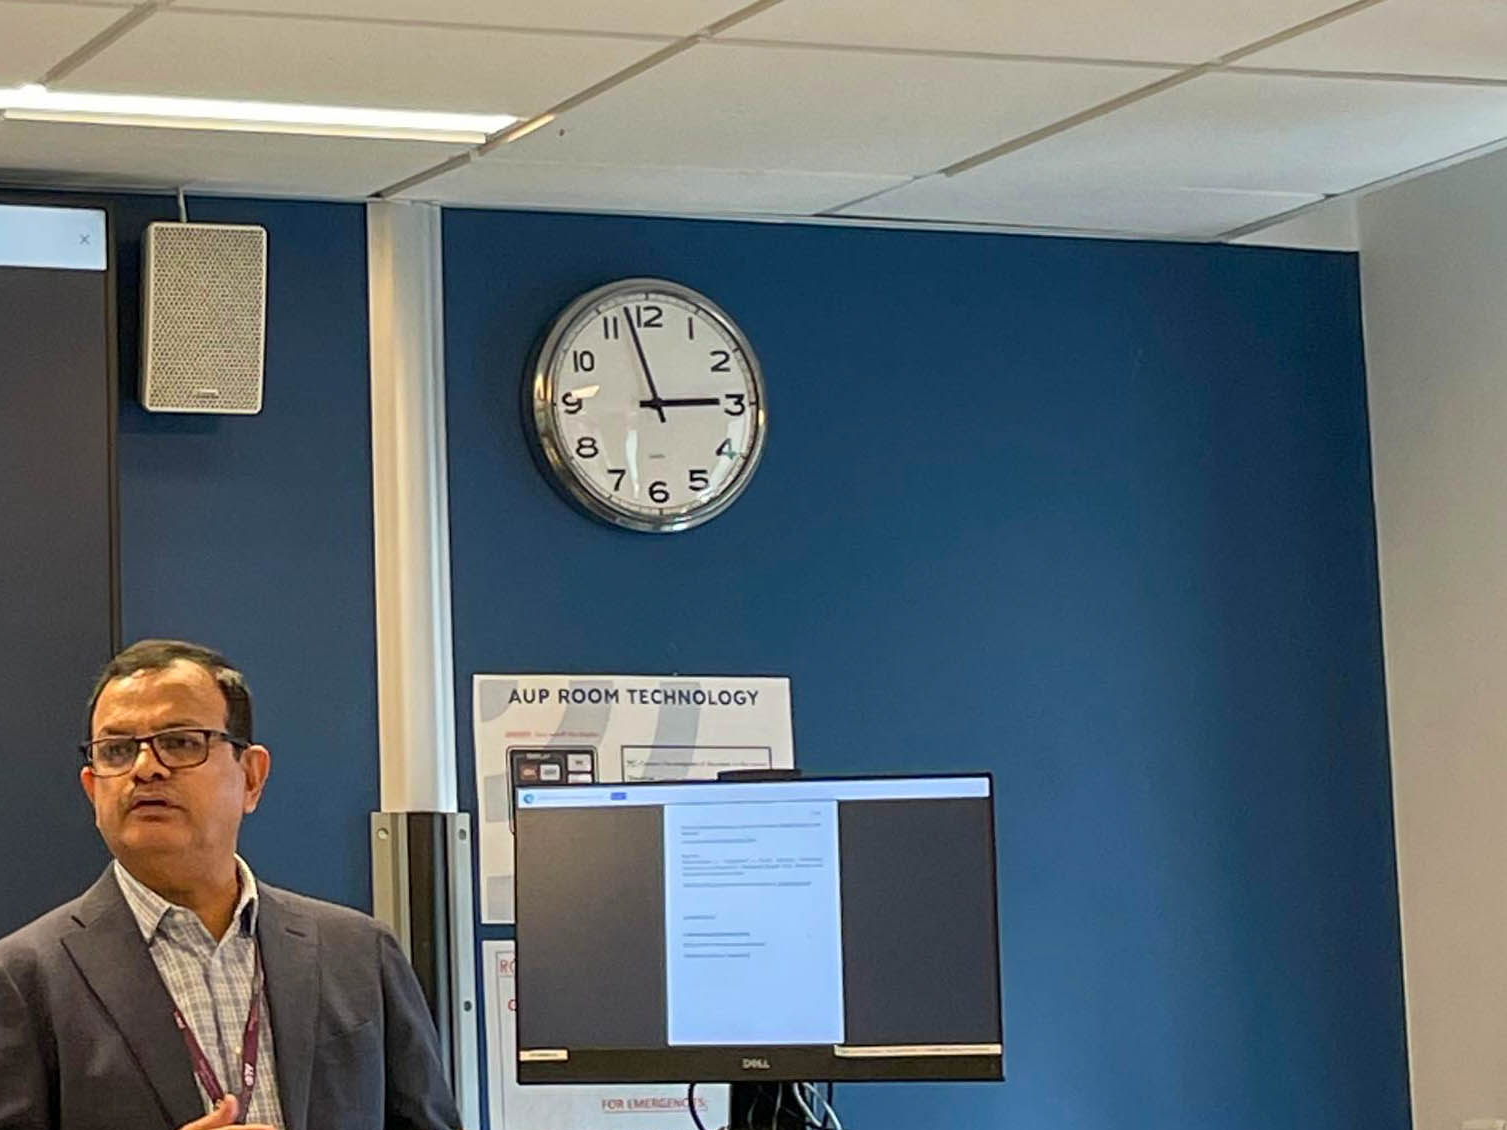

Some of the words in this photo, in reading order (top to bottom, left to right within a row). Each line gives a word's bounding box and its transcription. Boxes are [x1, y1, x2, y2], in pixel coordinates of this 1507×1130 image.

[602, 316, 619, 340] 11
[635, 305, 664, 328] 12
[687, 316, 695, 340] 1
[572, 350, 595, 373] 10
[709, 350, 732, 373] 2
[561, 391, 584, 415] 9
[723, 393, 746, 417] 3
[575, 436, 599, 459] 8
[715, 438, 738, 460] 4
[607, 469, 626, 492] 7
[688, 469, 709, 492] 5
[648, 481, 670, 504] 6
[508, 688, 550, 705] AUP
[558, 688, 620, 705] ROOM
[626, 688, 760, 706] TECHNOLOGY
[741, 1057, 771, 1070] DELL
[601, 1098, 624, 1110] FOR
